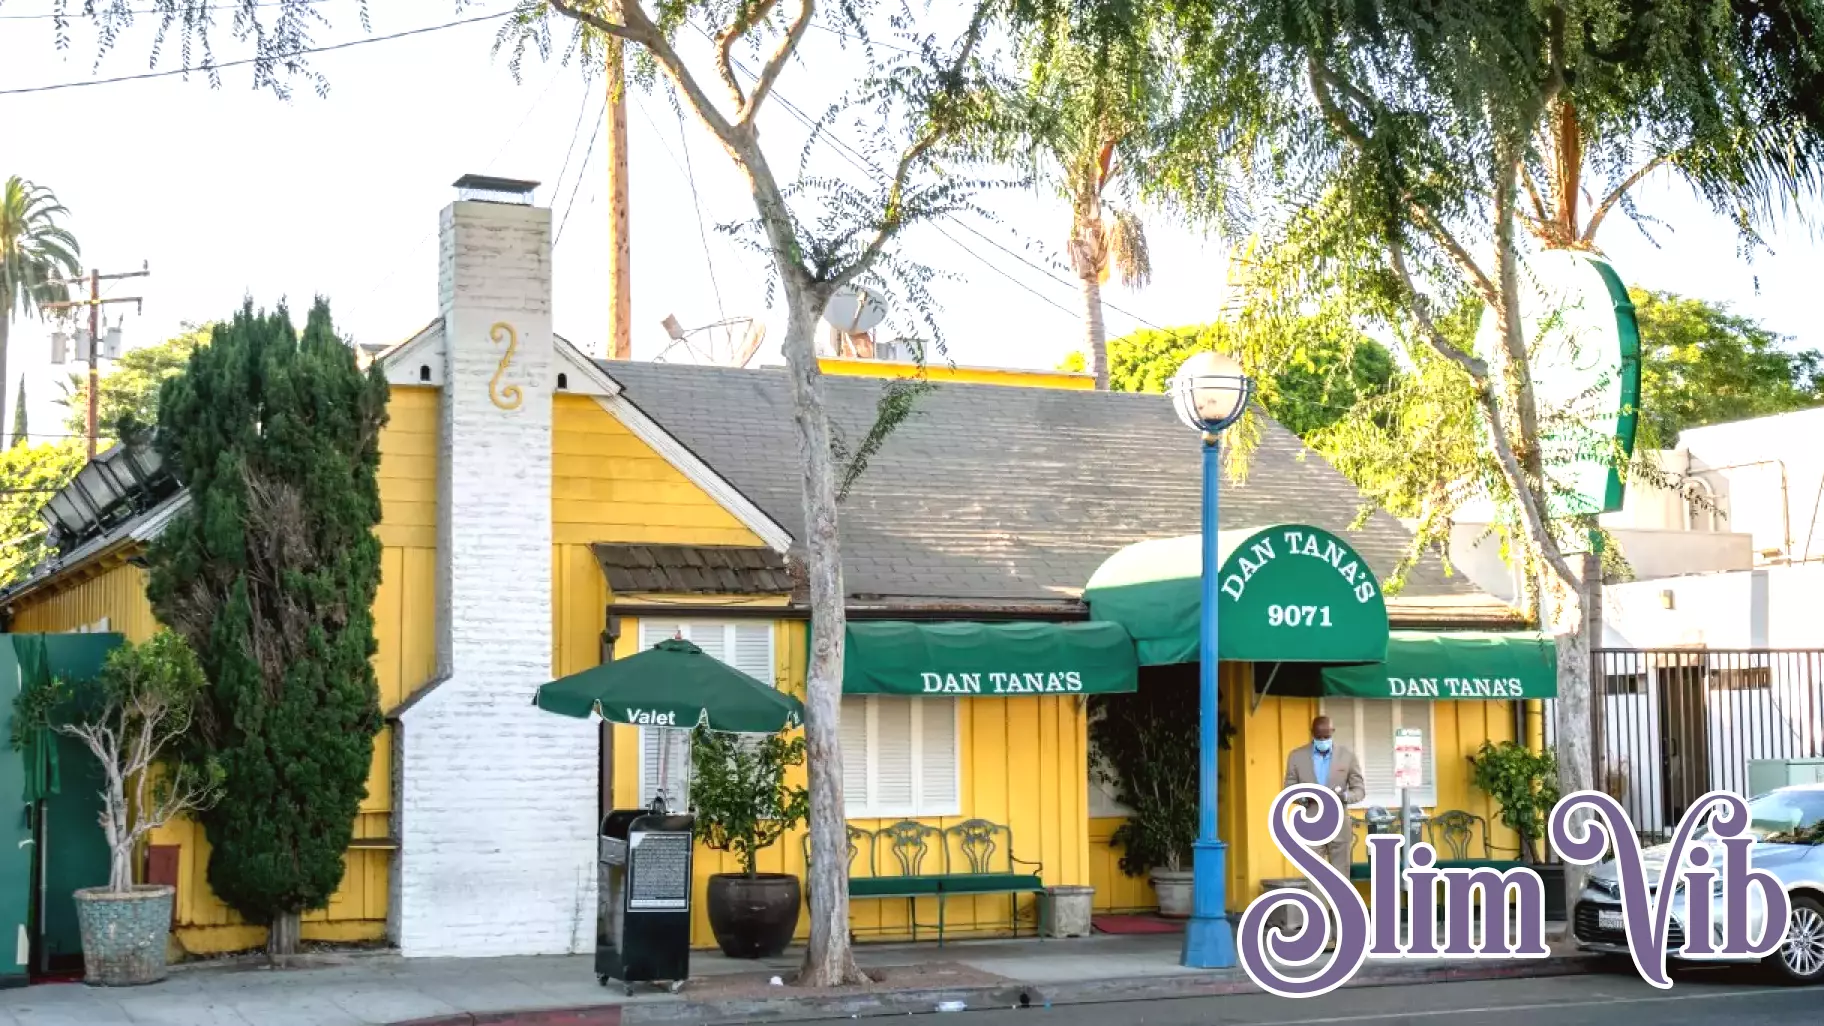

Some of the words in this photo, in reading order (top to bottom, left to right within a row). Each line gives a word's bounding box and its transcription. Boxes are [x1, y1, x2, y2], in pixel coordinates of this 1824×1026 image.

[1220, 536, 1276, 602] DAN
[1283, 530, 1377, 604] TANA'S
[1267, 603, 1333, 628] 9071
[920, 672, 982, 694] DAN
[988, 671, 1084, 694] TANA'S
[1386, 677, 1440, 697] DAN
[1443, 676, 1524, 697] TANA'S
[626, 707, 676, 726] Valet
